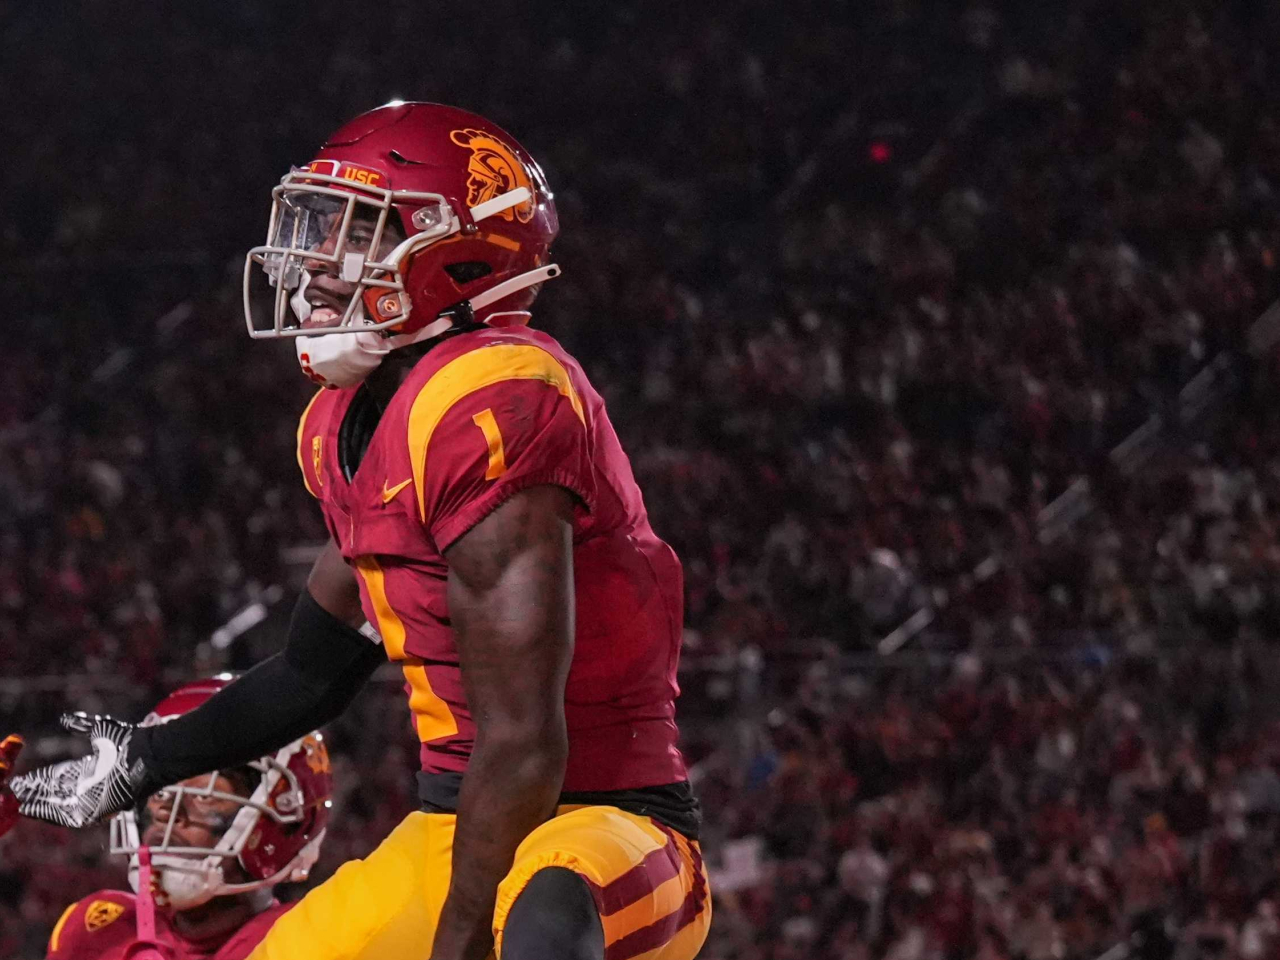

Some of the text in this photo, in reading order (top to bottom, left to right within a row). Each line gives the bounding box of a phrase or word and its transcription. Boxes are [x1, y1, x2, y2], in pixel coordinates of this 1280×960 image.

[344, 166, 380, 187] USC
[472, 407, 509, 482] 1
[354, 553, 459, 743] 1
